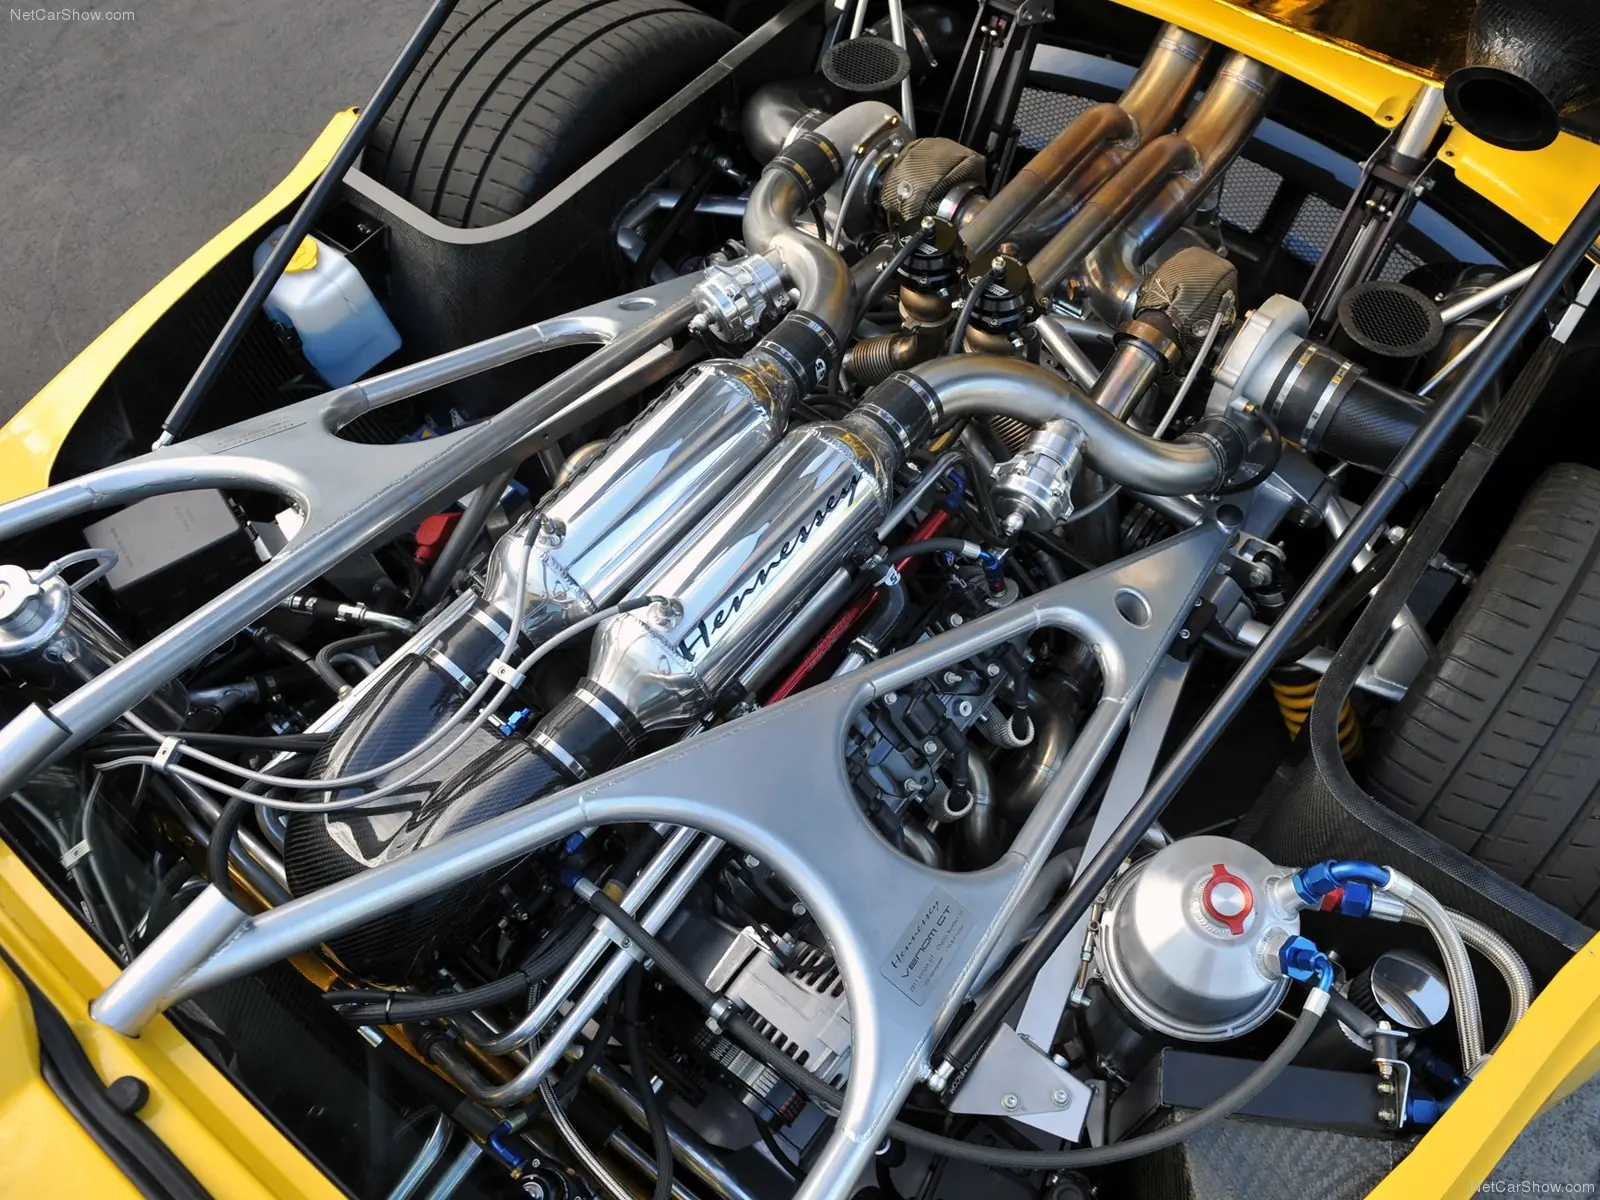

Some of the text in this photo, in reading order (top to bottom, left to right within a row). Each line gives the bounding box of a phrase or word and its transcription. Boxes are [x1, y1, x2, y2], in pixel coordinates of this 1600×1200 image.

[678, 472, 862, 662] Hennessey
[890, 900, 939, 968] Hennessey
[936, 905, 951, 926] GT
